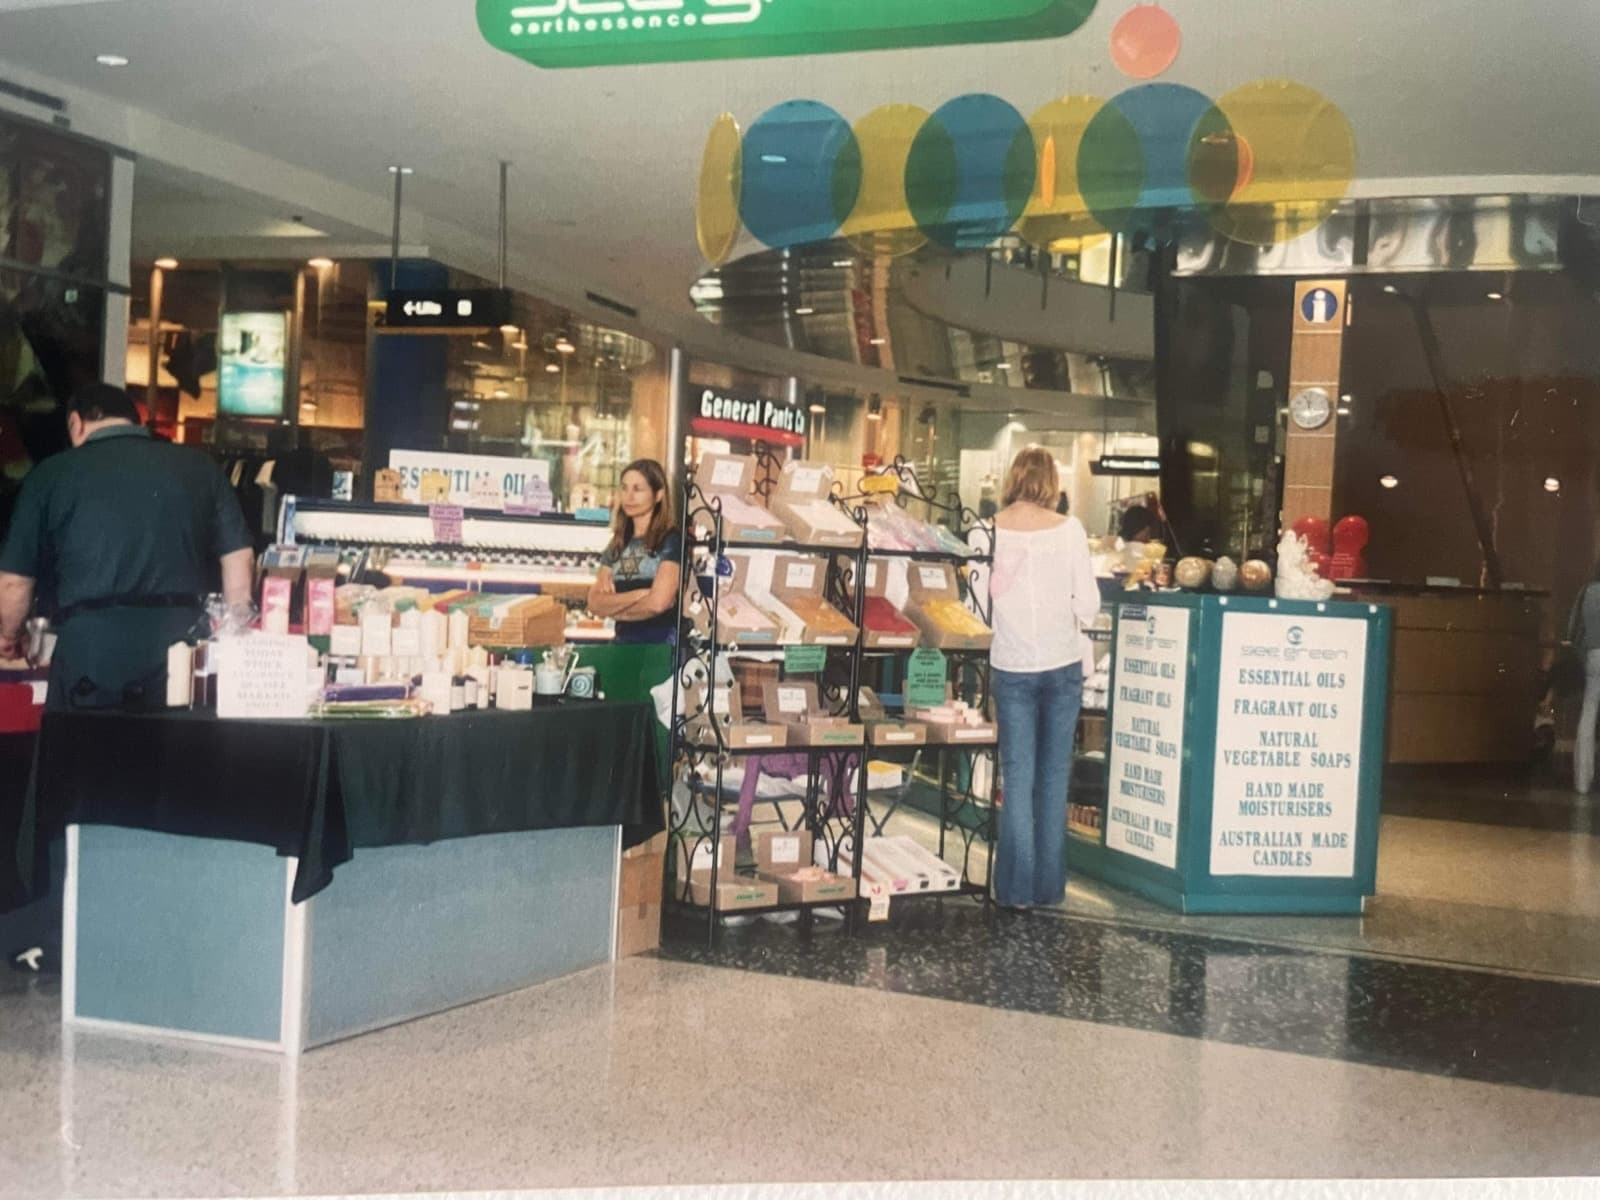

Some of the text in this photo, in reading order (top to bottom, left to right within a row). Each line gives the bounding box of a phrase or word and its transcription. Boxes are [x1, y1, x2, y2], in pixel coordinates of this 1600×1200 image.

[510, 13, 697, 36] earthessence
[701, 389, 760, 424] General
[764, 401, 793, 431] Pants
[1239, 668, 1346, 689] ESSENTIAL OILS
[1234, 699, 1338, 719] FRAGRANT OILS
[1259, 730, 1319, 748] NATURAL
[1223, 750, 1352, 769] VEGETABLE SOAPS
[1245, 781, 1325, 799] HAND MADE
[1238, 799, 1333, 817] MOISTURISERS
[1218, 830, 1350, 849] AUSTRALIAN MADE
[1253, 849, 1313, 867] CANDLES
